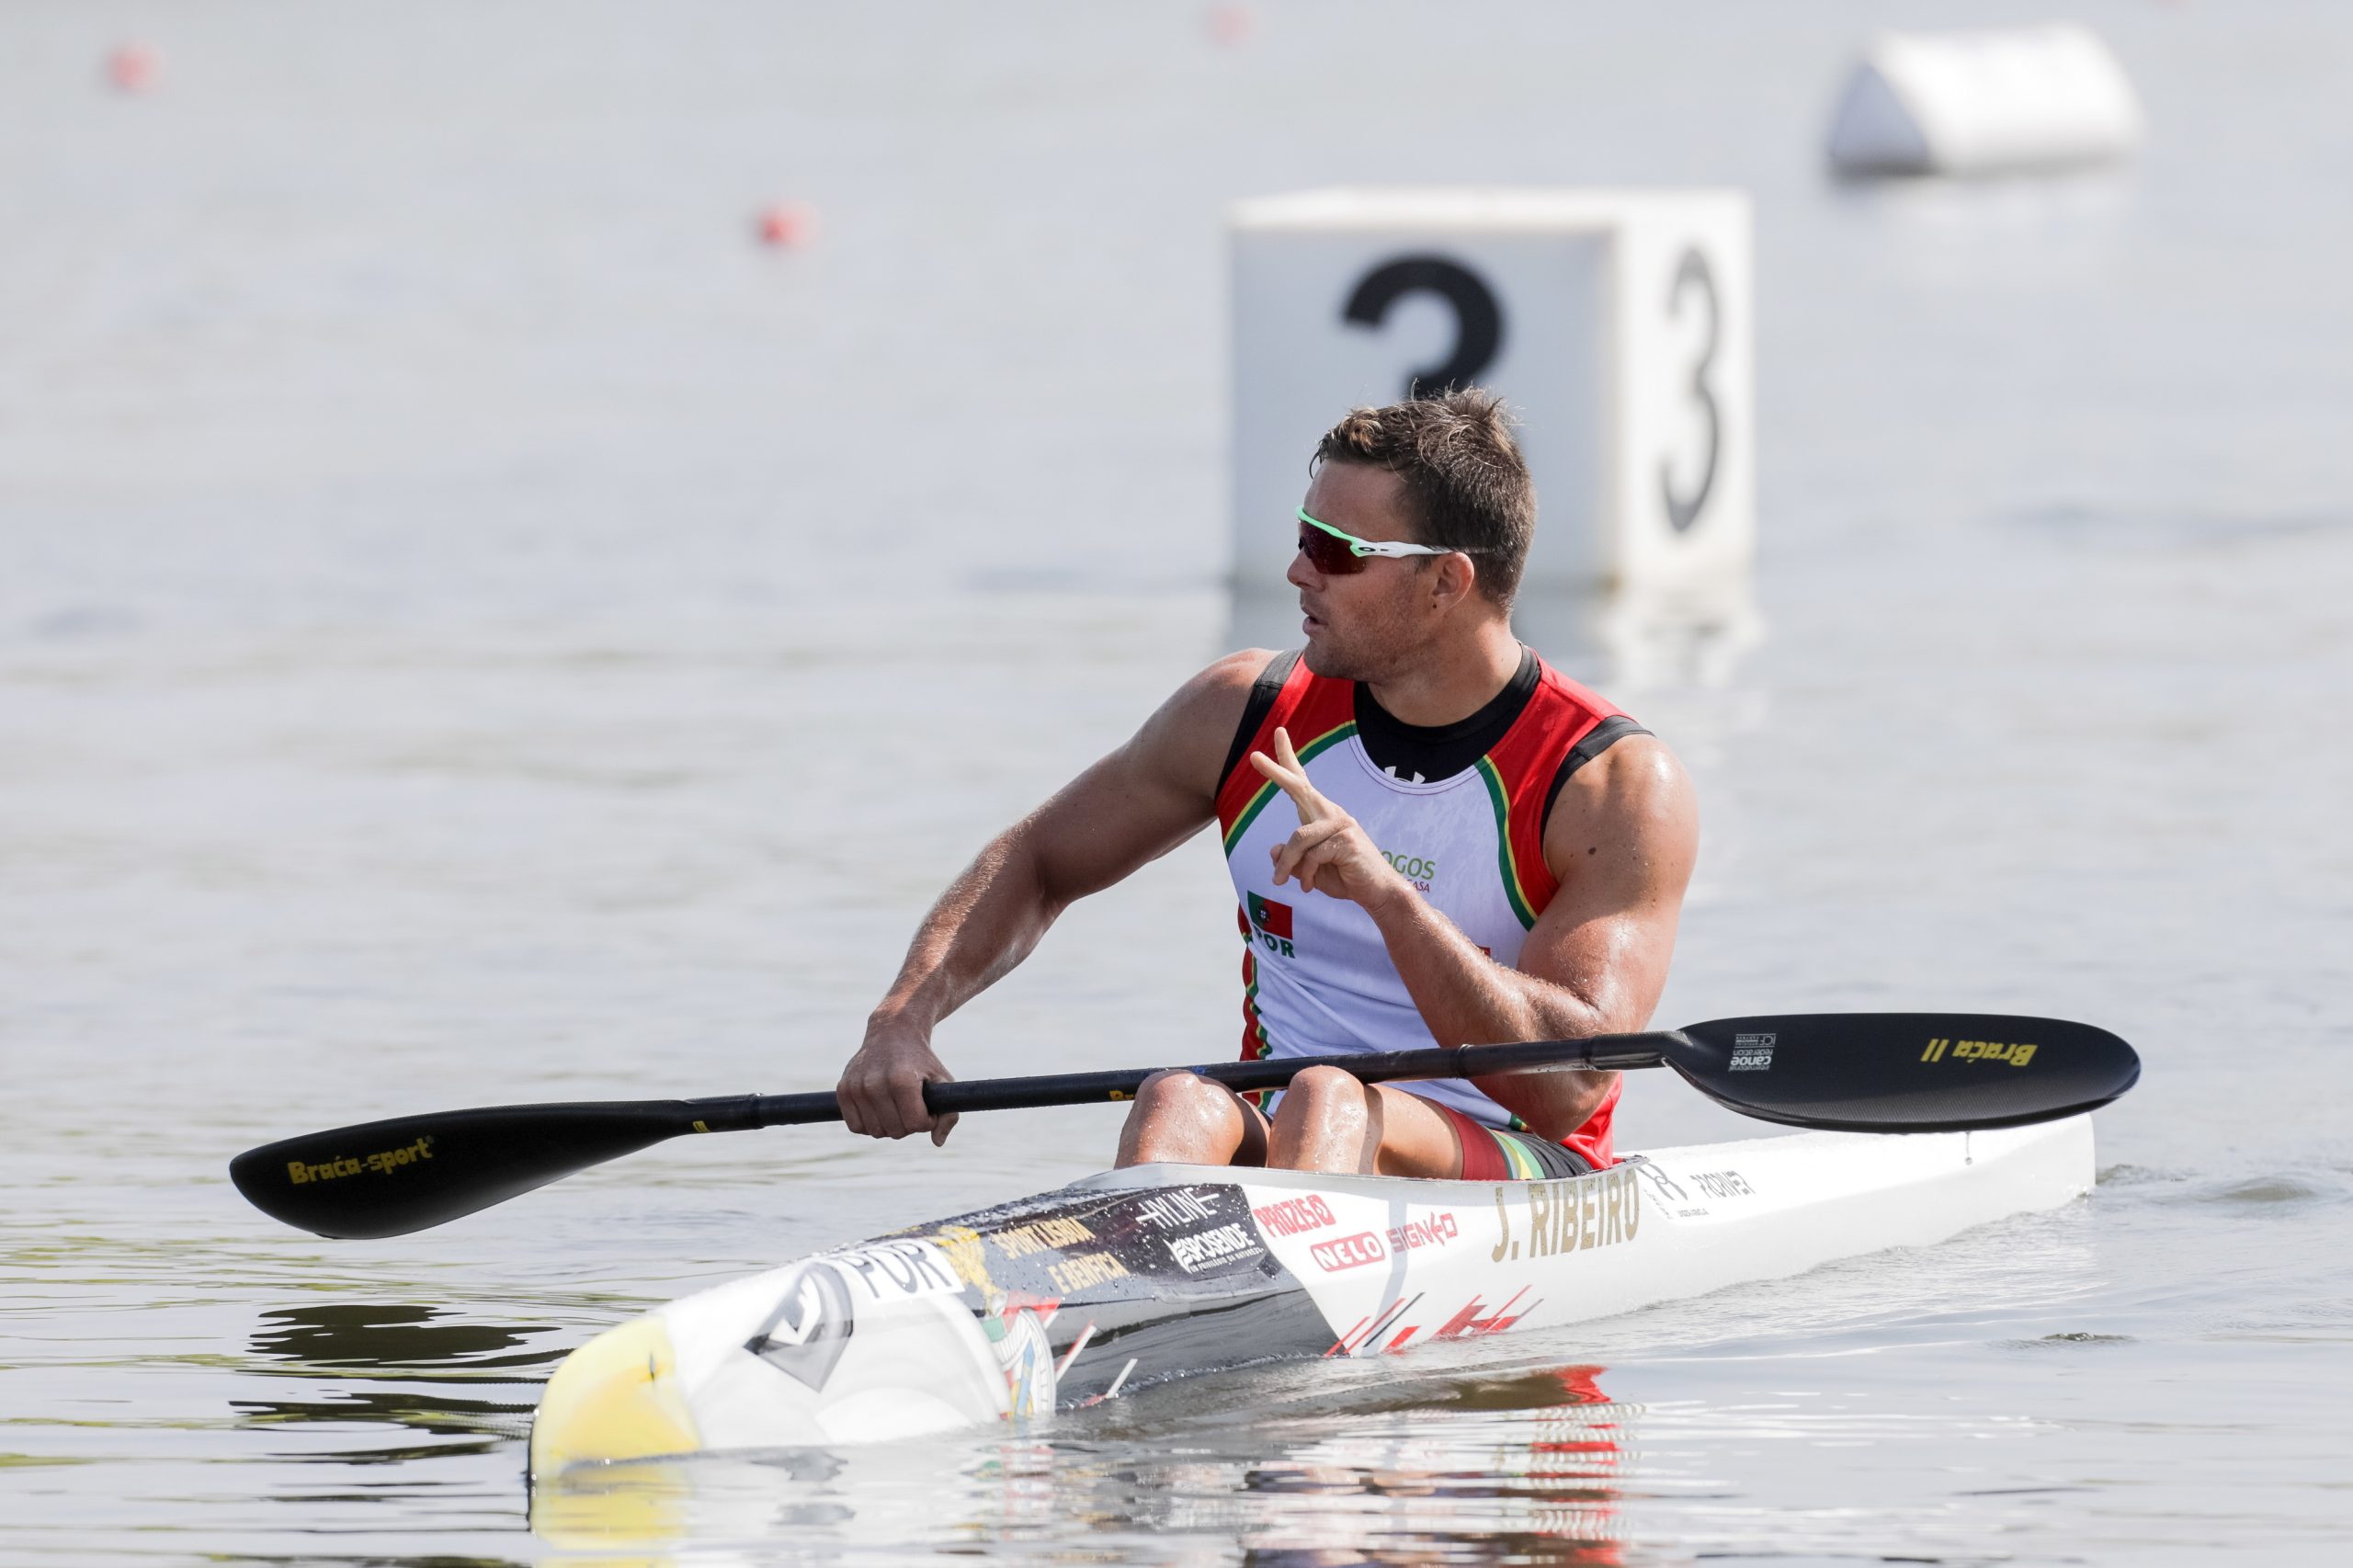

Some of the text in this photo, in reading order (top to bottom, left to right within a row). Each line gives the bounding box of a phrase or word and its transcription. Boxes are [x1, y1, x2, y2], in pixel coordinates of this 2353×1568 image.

[1662, 246, 1720, 533] 3
[1381, 850, 1436, 881] OGOS
[1407, 879, 1430, 893] ASA
[1253, 924, 1296, 959] POR
[1730, 1056, 1772, 1066] canoe
[1135, 1187, 1220, 1230] HYLINE
[1253, 1197, 1322, 1238] PROZIS
[1492, 1167, 1640, 1263] J. RIBEIRO
[992, 1216, 1096, 1259] SPORT LISBOA
[1312, 1235, 1382, 1268] NELO
[830, 1243, 952, 1298] POR
[1047, 1251, 1131, 1295] E BENFICA
